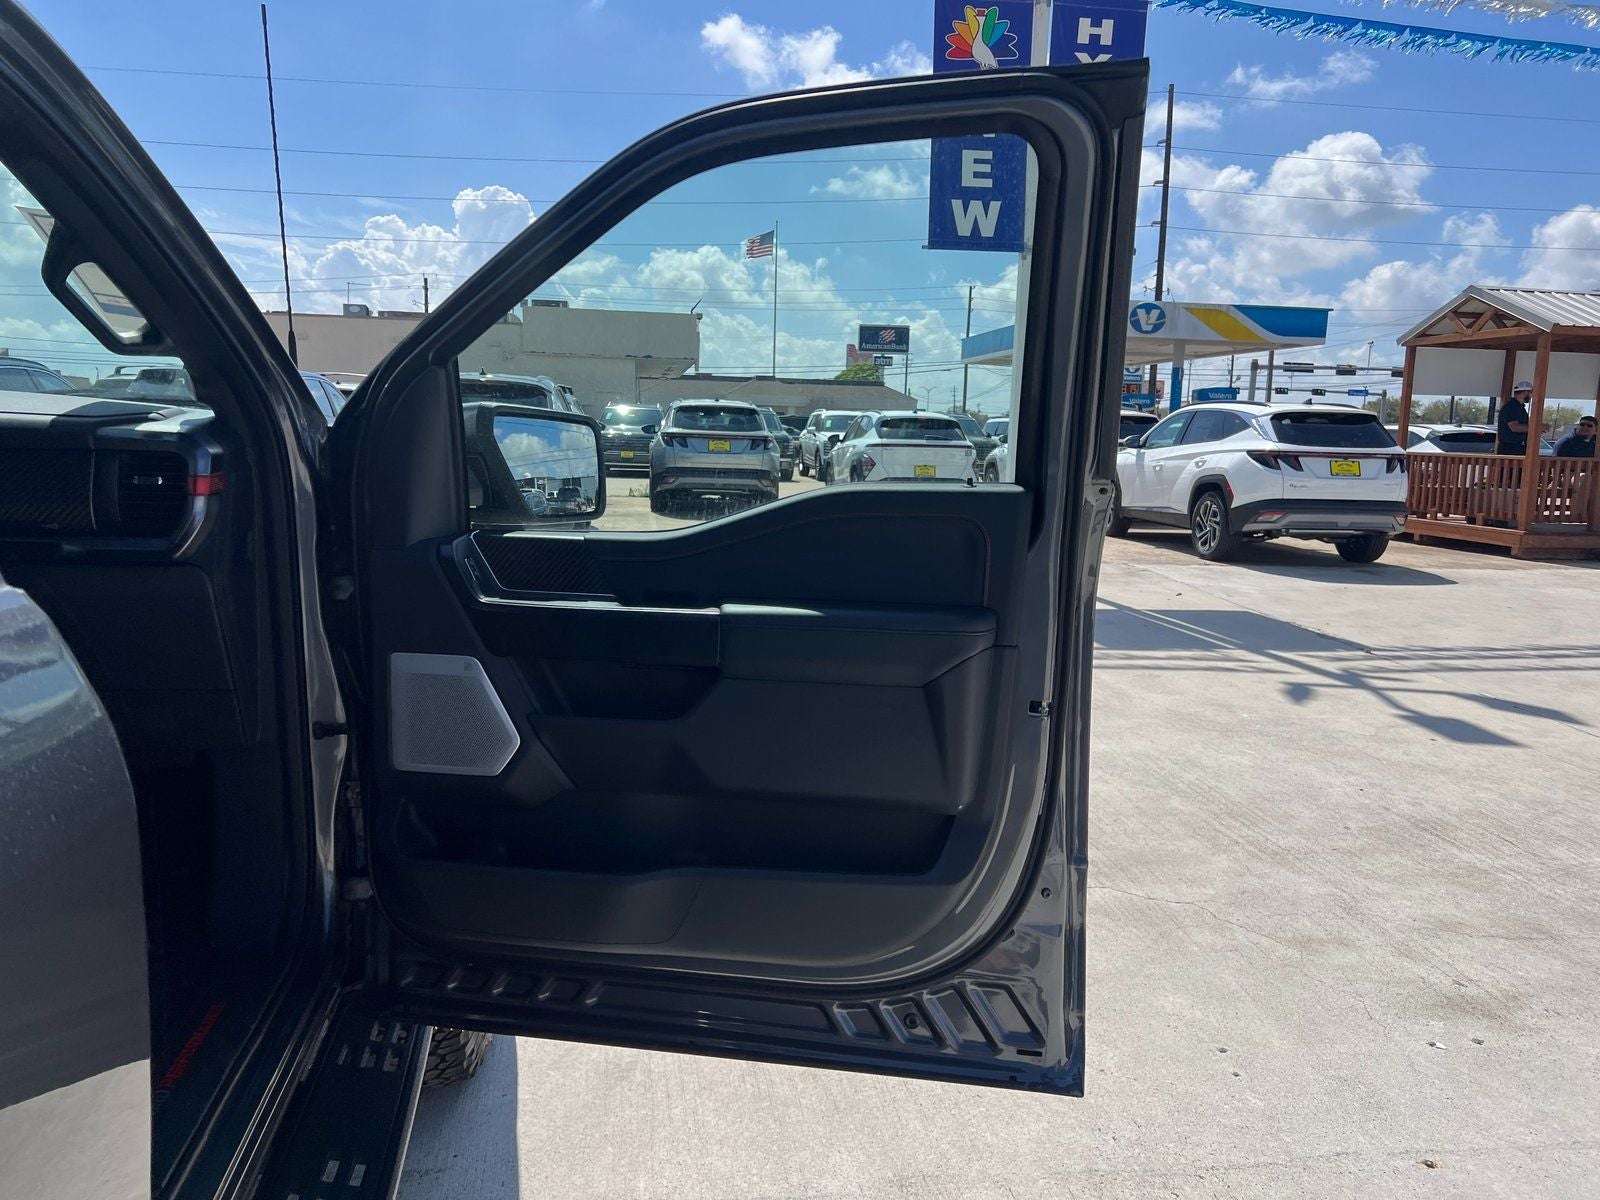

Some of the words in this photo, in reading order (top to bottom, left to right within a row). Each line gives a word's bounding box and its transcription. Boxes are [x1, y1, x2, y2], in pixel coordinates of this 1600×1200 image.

[951, 134, 1001, 238] EW
[875, 357, 892, 365] atm
[1208, 391, 1232, 399] Valero
